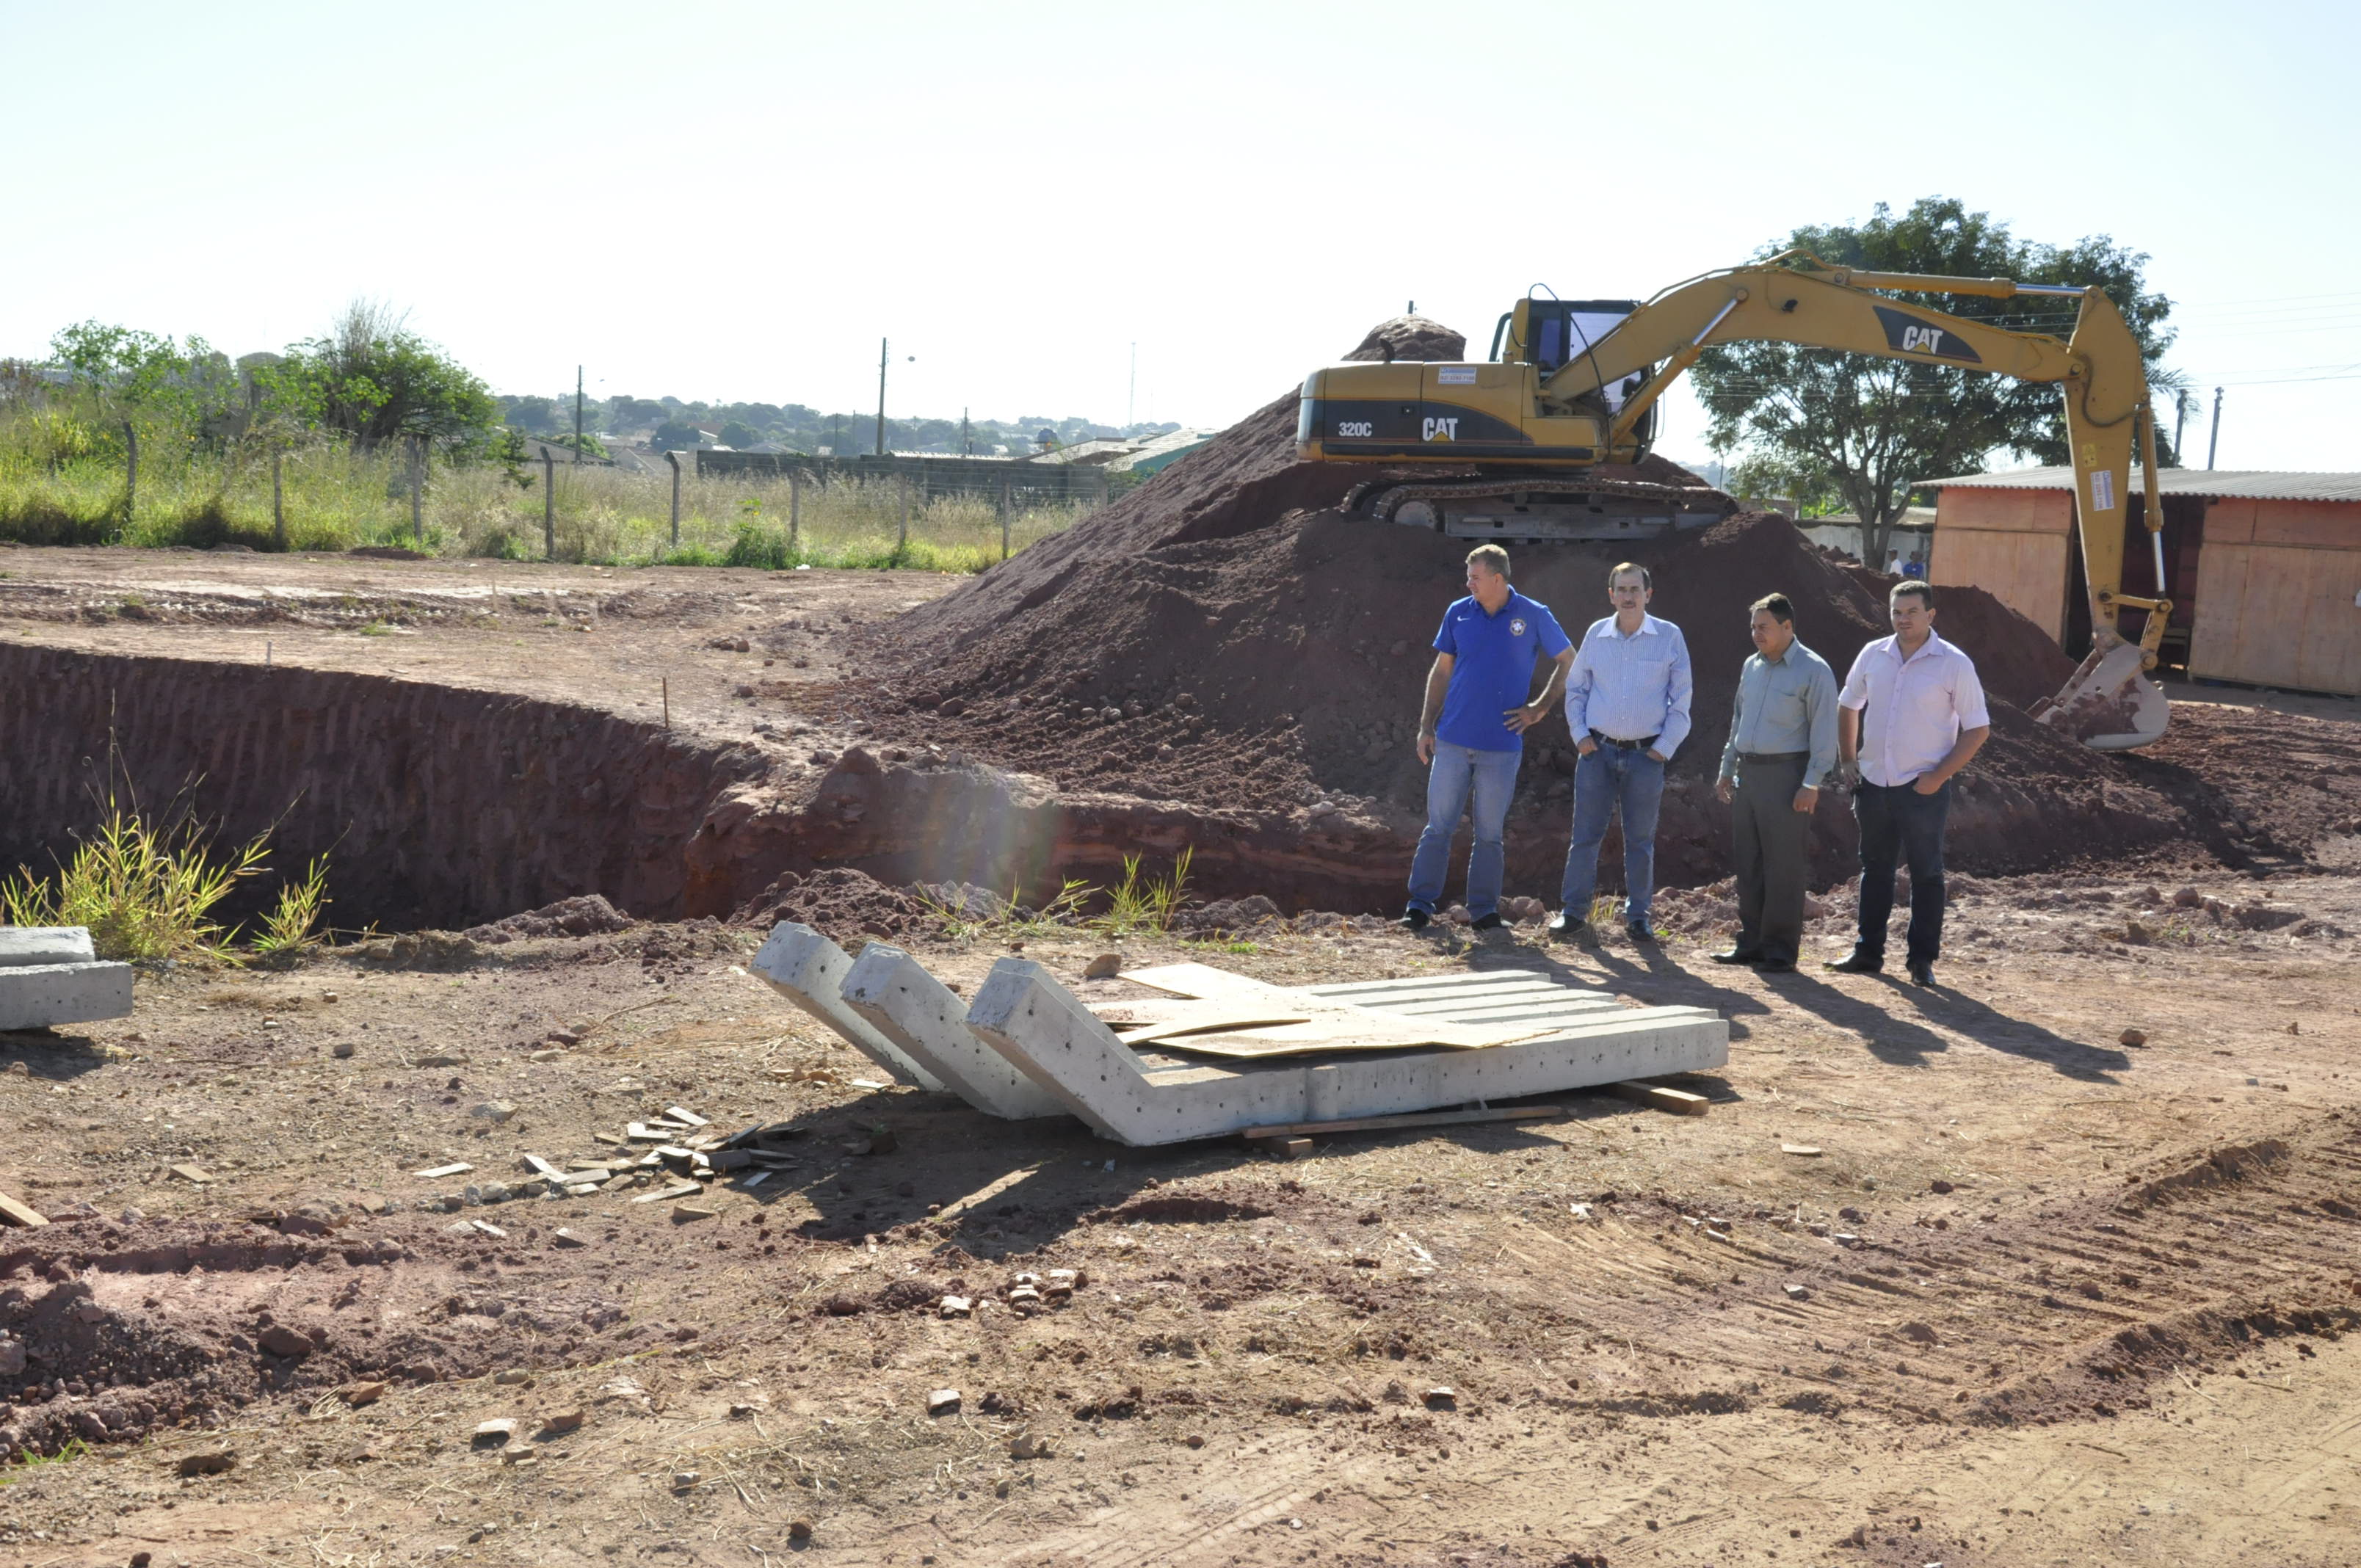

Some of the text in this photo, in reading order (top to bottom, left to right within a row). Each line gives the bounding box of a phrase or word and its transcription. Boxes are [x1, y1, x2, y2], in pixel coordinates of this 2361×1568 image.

[1903, 325, 1943, 355] CAT
[1339, 422, 1372, 437] 320C
[1423, 417, 1458, 442] CAT
